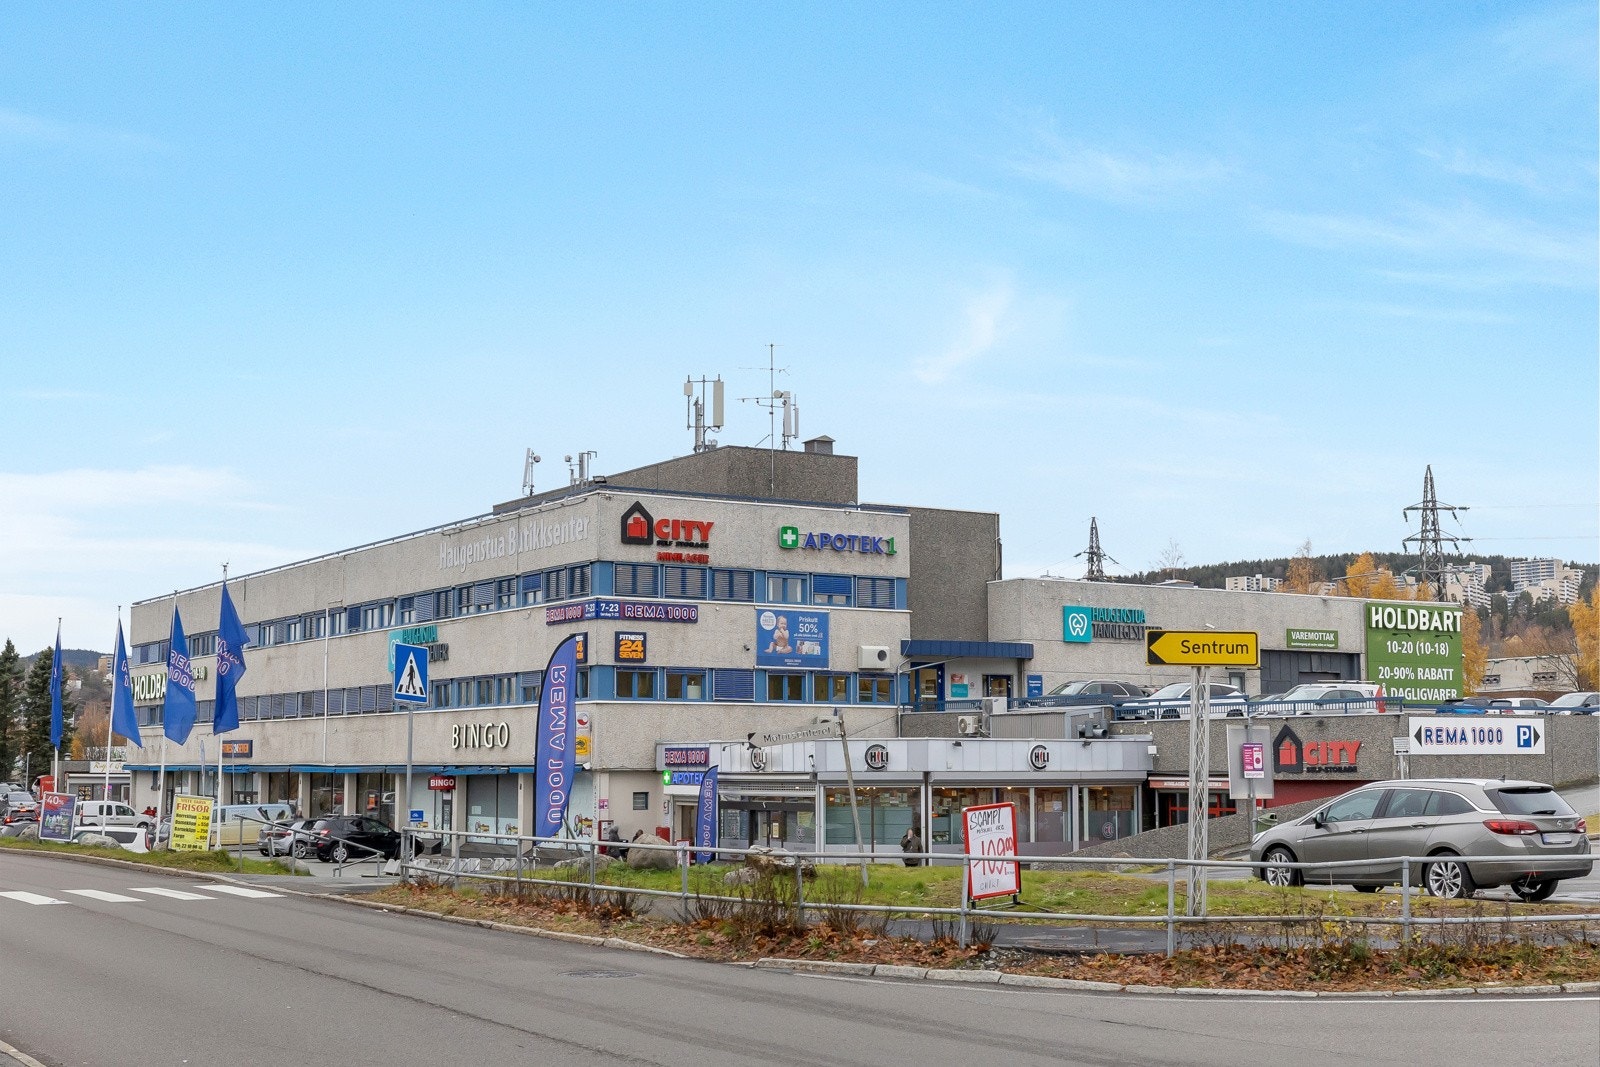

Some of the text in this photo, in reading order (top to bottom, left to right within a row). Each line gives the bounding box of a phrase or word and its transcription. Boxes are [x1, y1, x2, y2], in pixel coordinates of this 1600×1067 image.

[654, 518, 715, 542] CITY
[439, 515, 591, 573] Haugenstua Butikksenter
[804, 532, 884, 554] APOTEK
[546, 609, 565, 622] REMA
[566, 605, 583, 620] 1000
[600, 603, 619, 612] 7-23
[625, 605, 665, 618] REMA
[668, 607, 697, 620] 1000
[1092, 607, 1146, 624] HAUGENSTUA
[1371, 606, 1463, 632] HOLDBART
[799, 624, 819, 633] 50%
[1291, 631, 1335, 641] VAREMOTTAK
[620, 640, 644, 652] 24
[1181, 639, 1249, 655] Sentrum
[1386, 640, 1449, 657] 10-20 (10-18)
[1378, 666, 1454, 680] 20-90% RABATT
[452, 722, 510, 749] BINGO
[1425, 727, 1468, 745] REMA
[1472, 727, 1503, 745] 1000
[1519, 727, 1530, 746] P
[664, 750, 706, 764] REMA 1000
[1303, 740, 1361, 765] CITY
[430, 779, 455, 787] BINGO
[176, 803, 210, 813] FRISØR
[969, 808, 1002, 831] SCAMPI
